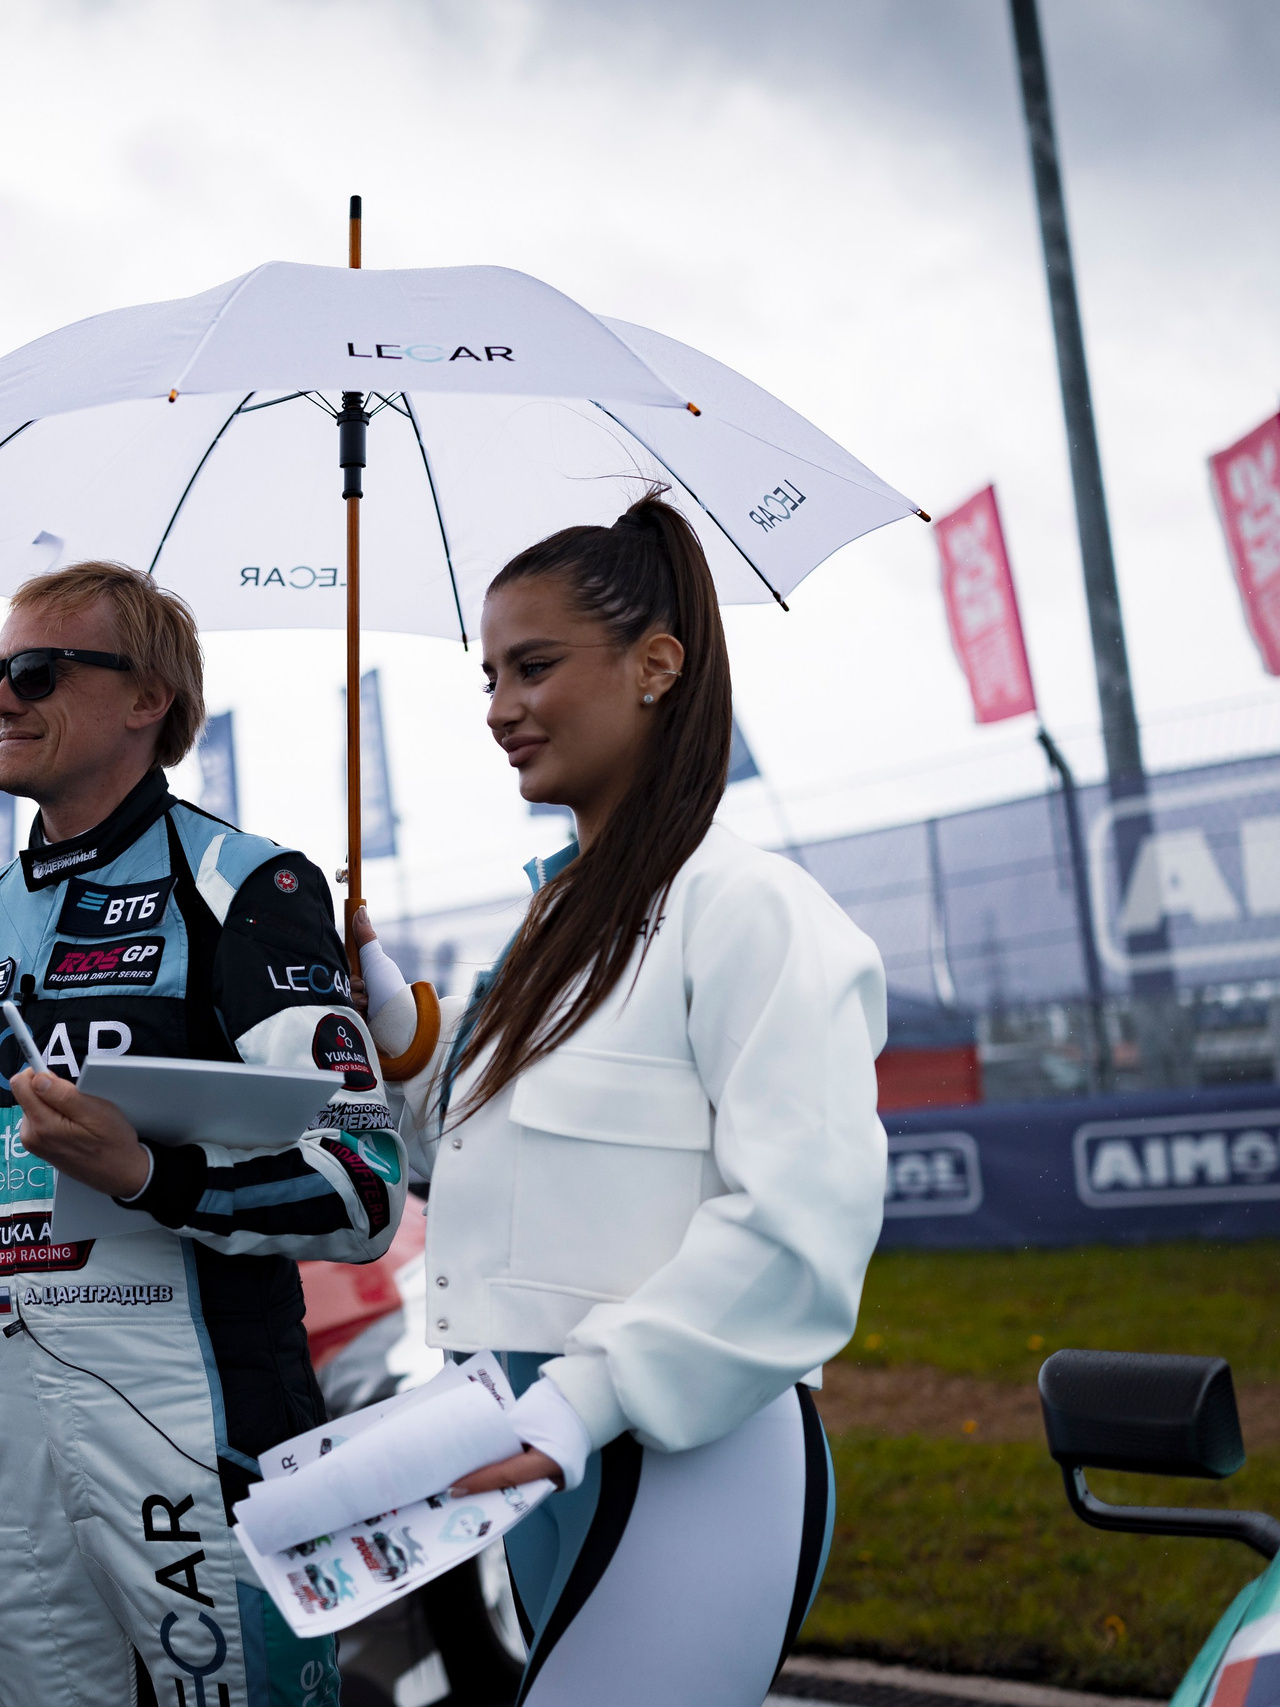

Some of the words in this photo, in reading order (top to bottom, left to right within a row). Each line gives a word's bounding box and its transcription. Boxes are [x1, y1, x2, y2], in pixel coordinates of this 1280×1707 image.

[347, 342, 516, 363] LECAR
[103, 891, 160, 925] ВТБ
[55, 946, 127, 973] RDS
[122, 945, 159, 962] GP
[49, 972, 91, 982] RUSSIAN
[90, 971, 118, 981] DRIFT
[118, 971, 153, 979] SERIES
[325, 1051, 354, 1062] YUKA
[335, 1064, 349, 1072] PRO
[20, 1246, 72, 1261] RACING
[42, 1285, 173, 1306] ЦАРЕГРАДЦЕВ
